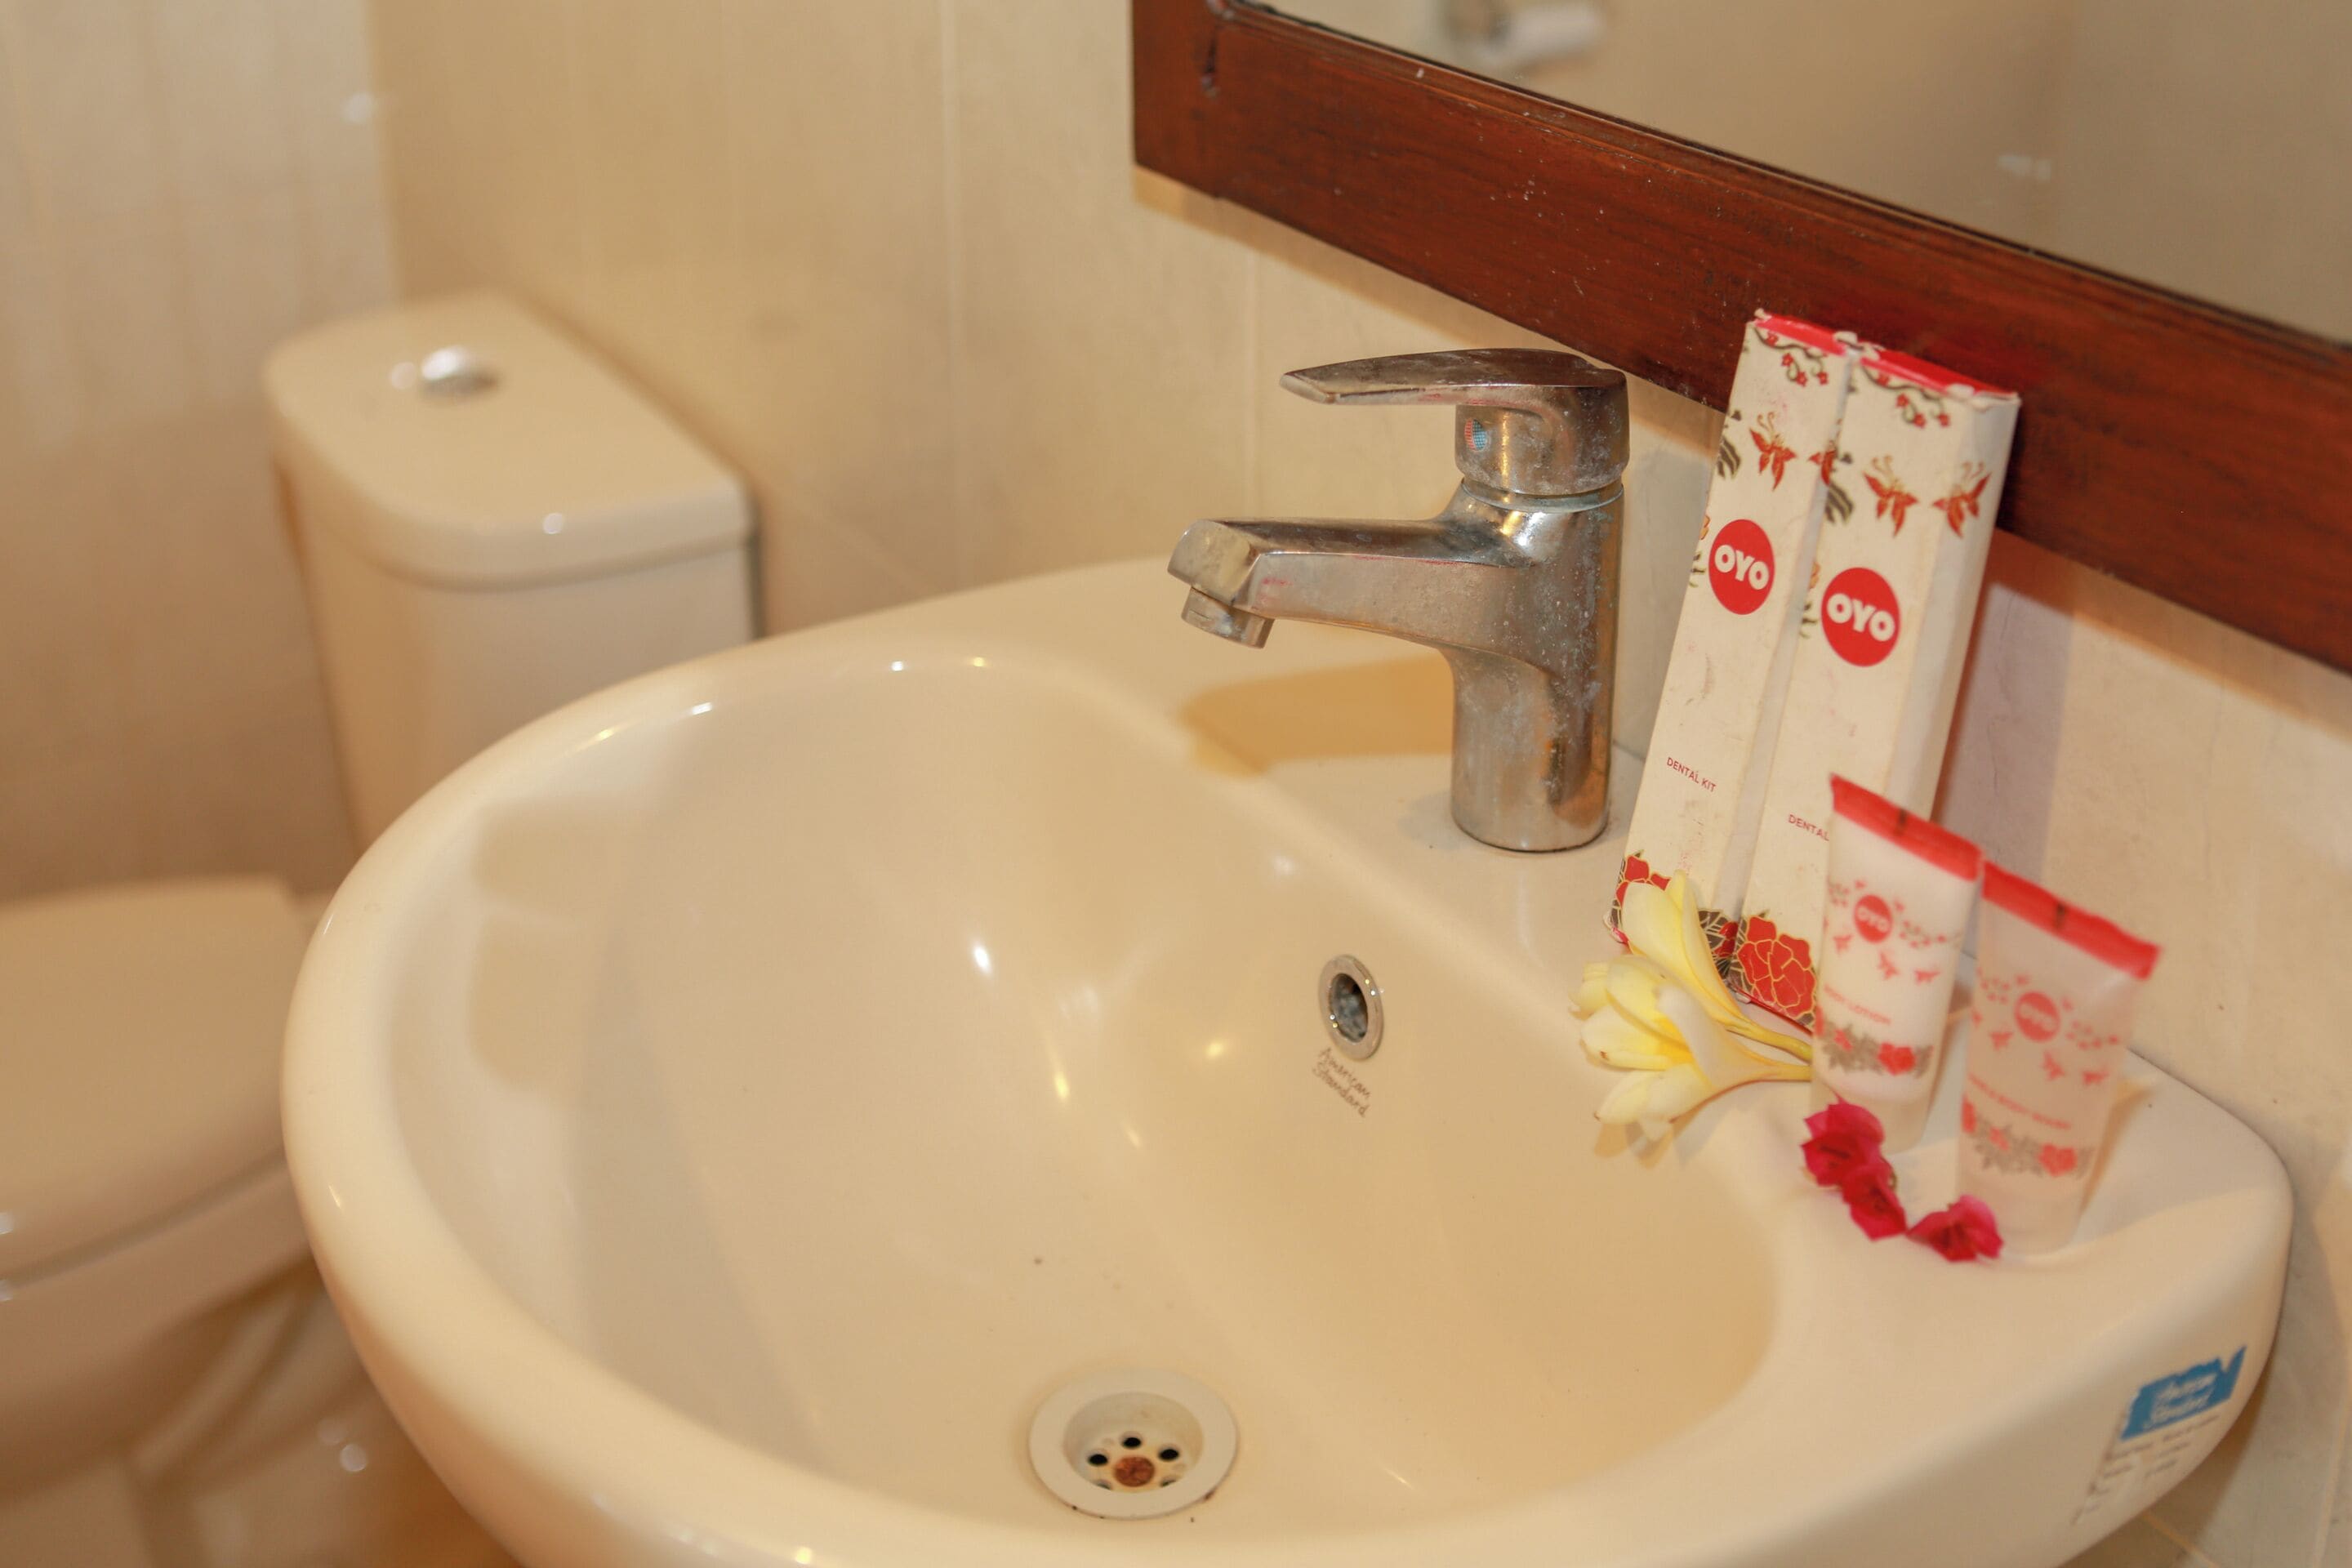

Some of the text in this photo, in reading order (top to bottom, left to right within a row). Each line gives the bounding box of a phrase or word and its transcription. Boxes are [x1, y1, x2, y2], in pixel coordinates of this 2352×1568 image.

[1714, 544, 1770, 590] OYO
[1827, 592, 1895, 642] OYO
[1667, 756, 1716, 792] DENTAL KIT
[1788, 813, 1829, 841] DENTAL
[1312, 1061, 1370, 1118] Standard
